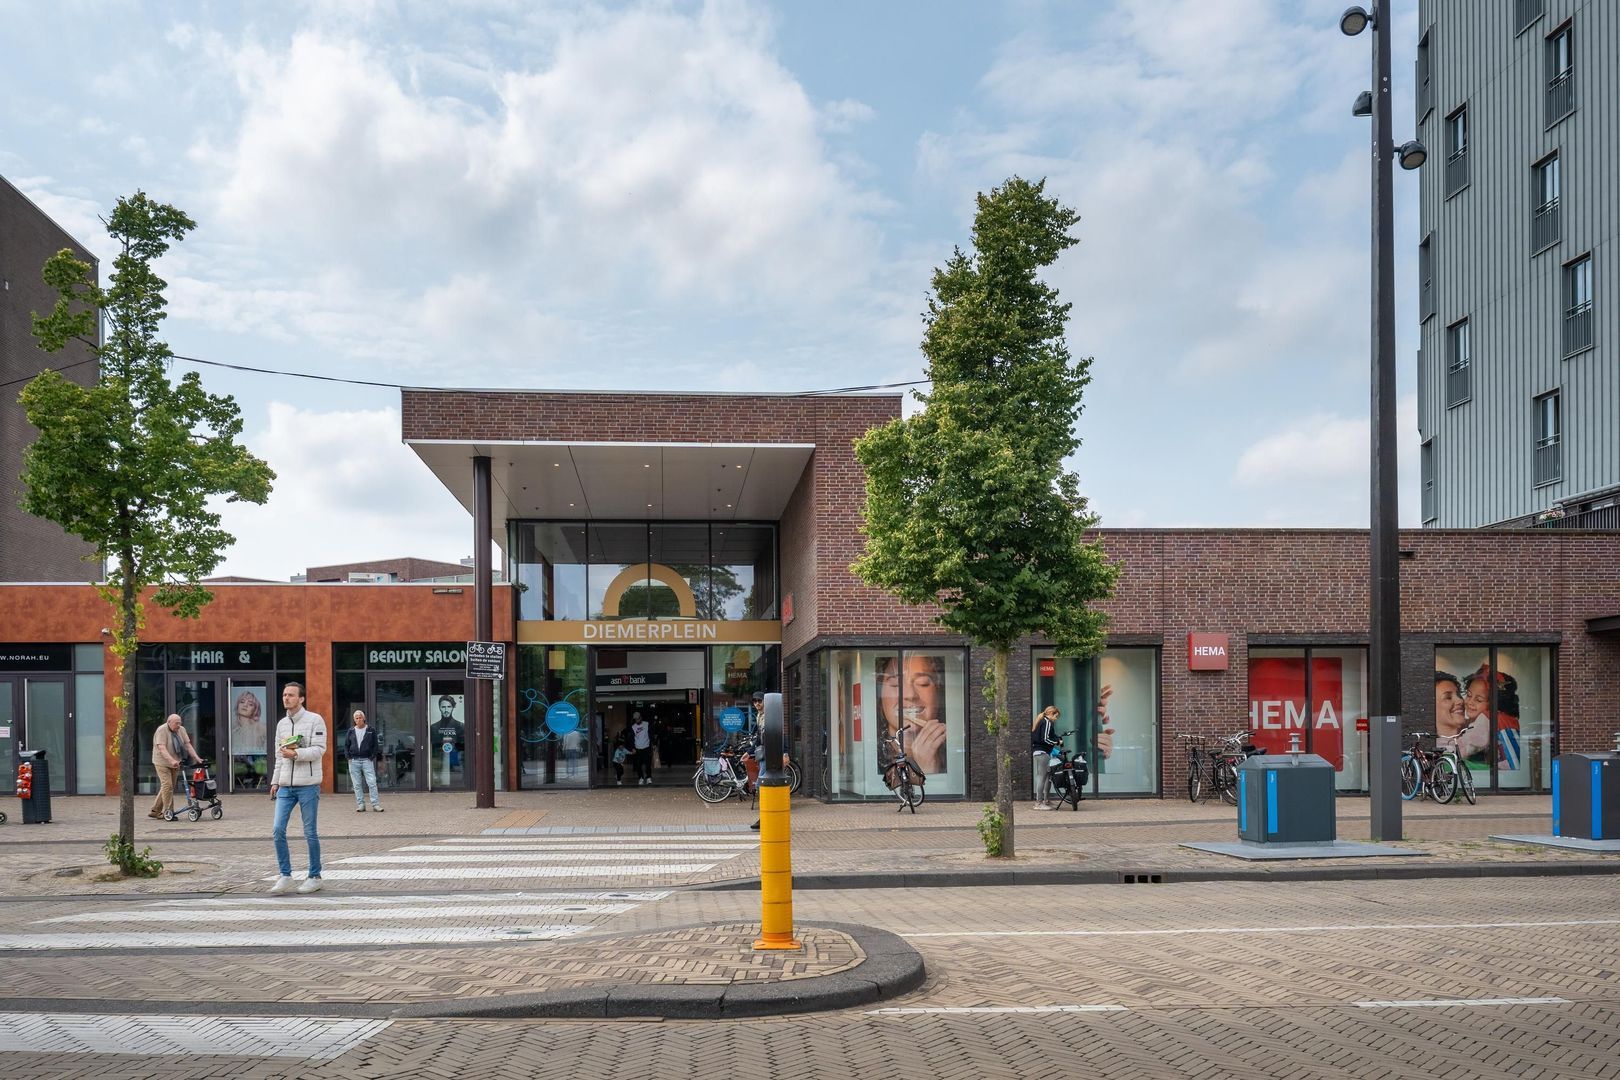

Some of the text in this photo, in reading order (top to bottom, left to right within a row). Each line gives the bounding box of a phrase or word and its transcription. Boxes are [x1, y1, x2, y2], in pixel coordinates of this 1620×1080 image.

[583, 624, 717, 639] DIEMERPLEIN
[191, 650, 251, 664] HAIR &
[369, 650, 421, 663] BEAUTY
[1194, 646, 1226, 656] HEMA
[610, 675, 646, 685] asn bank
